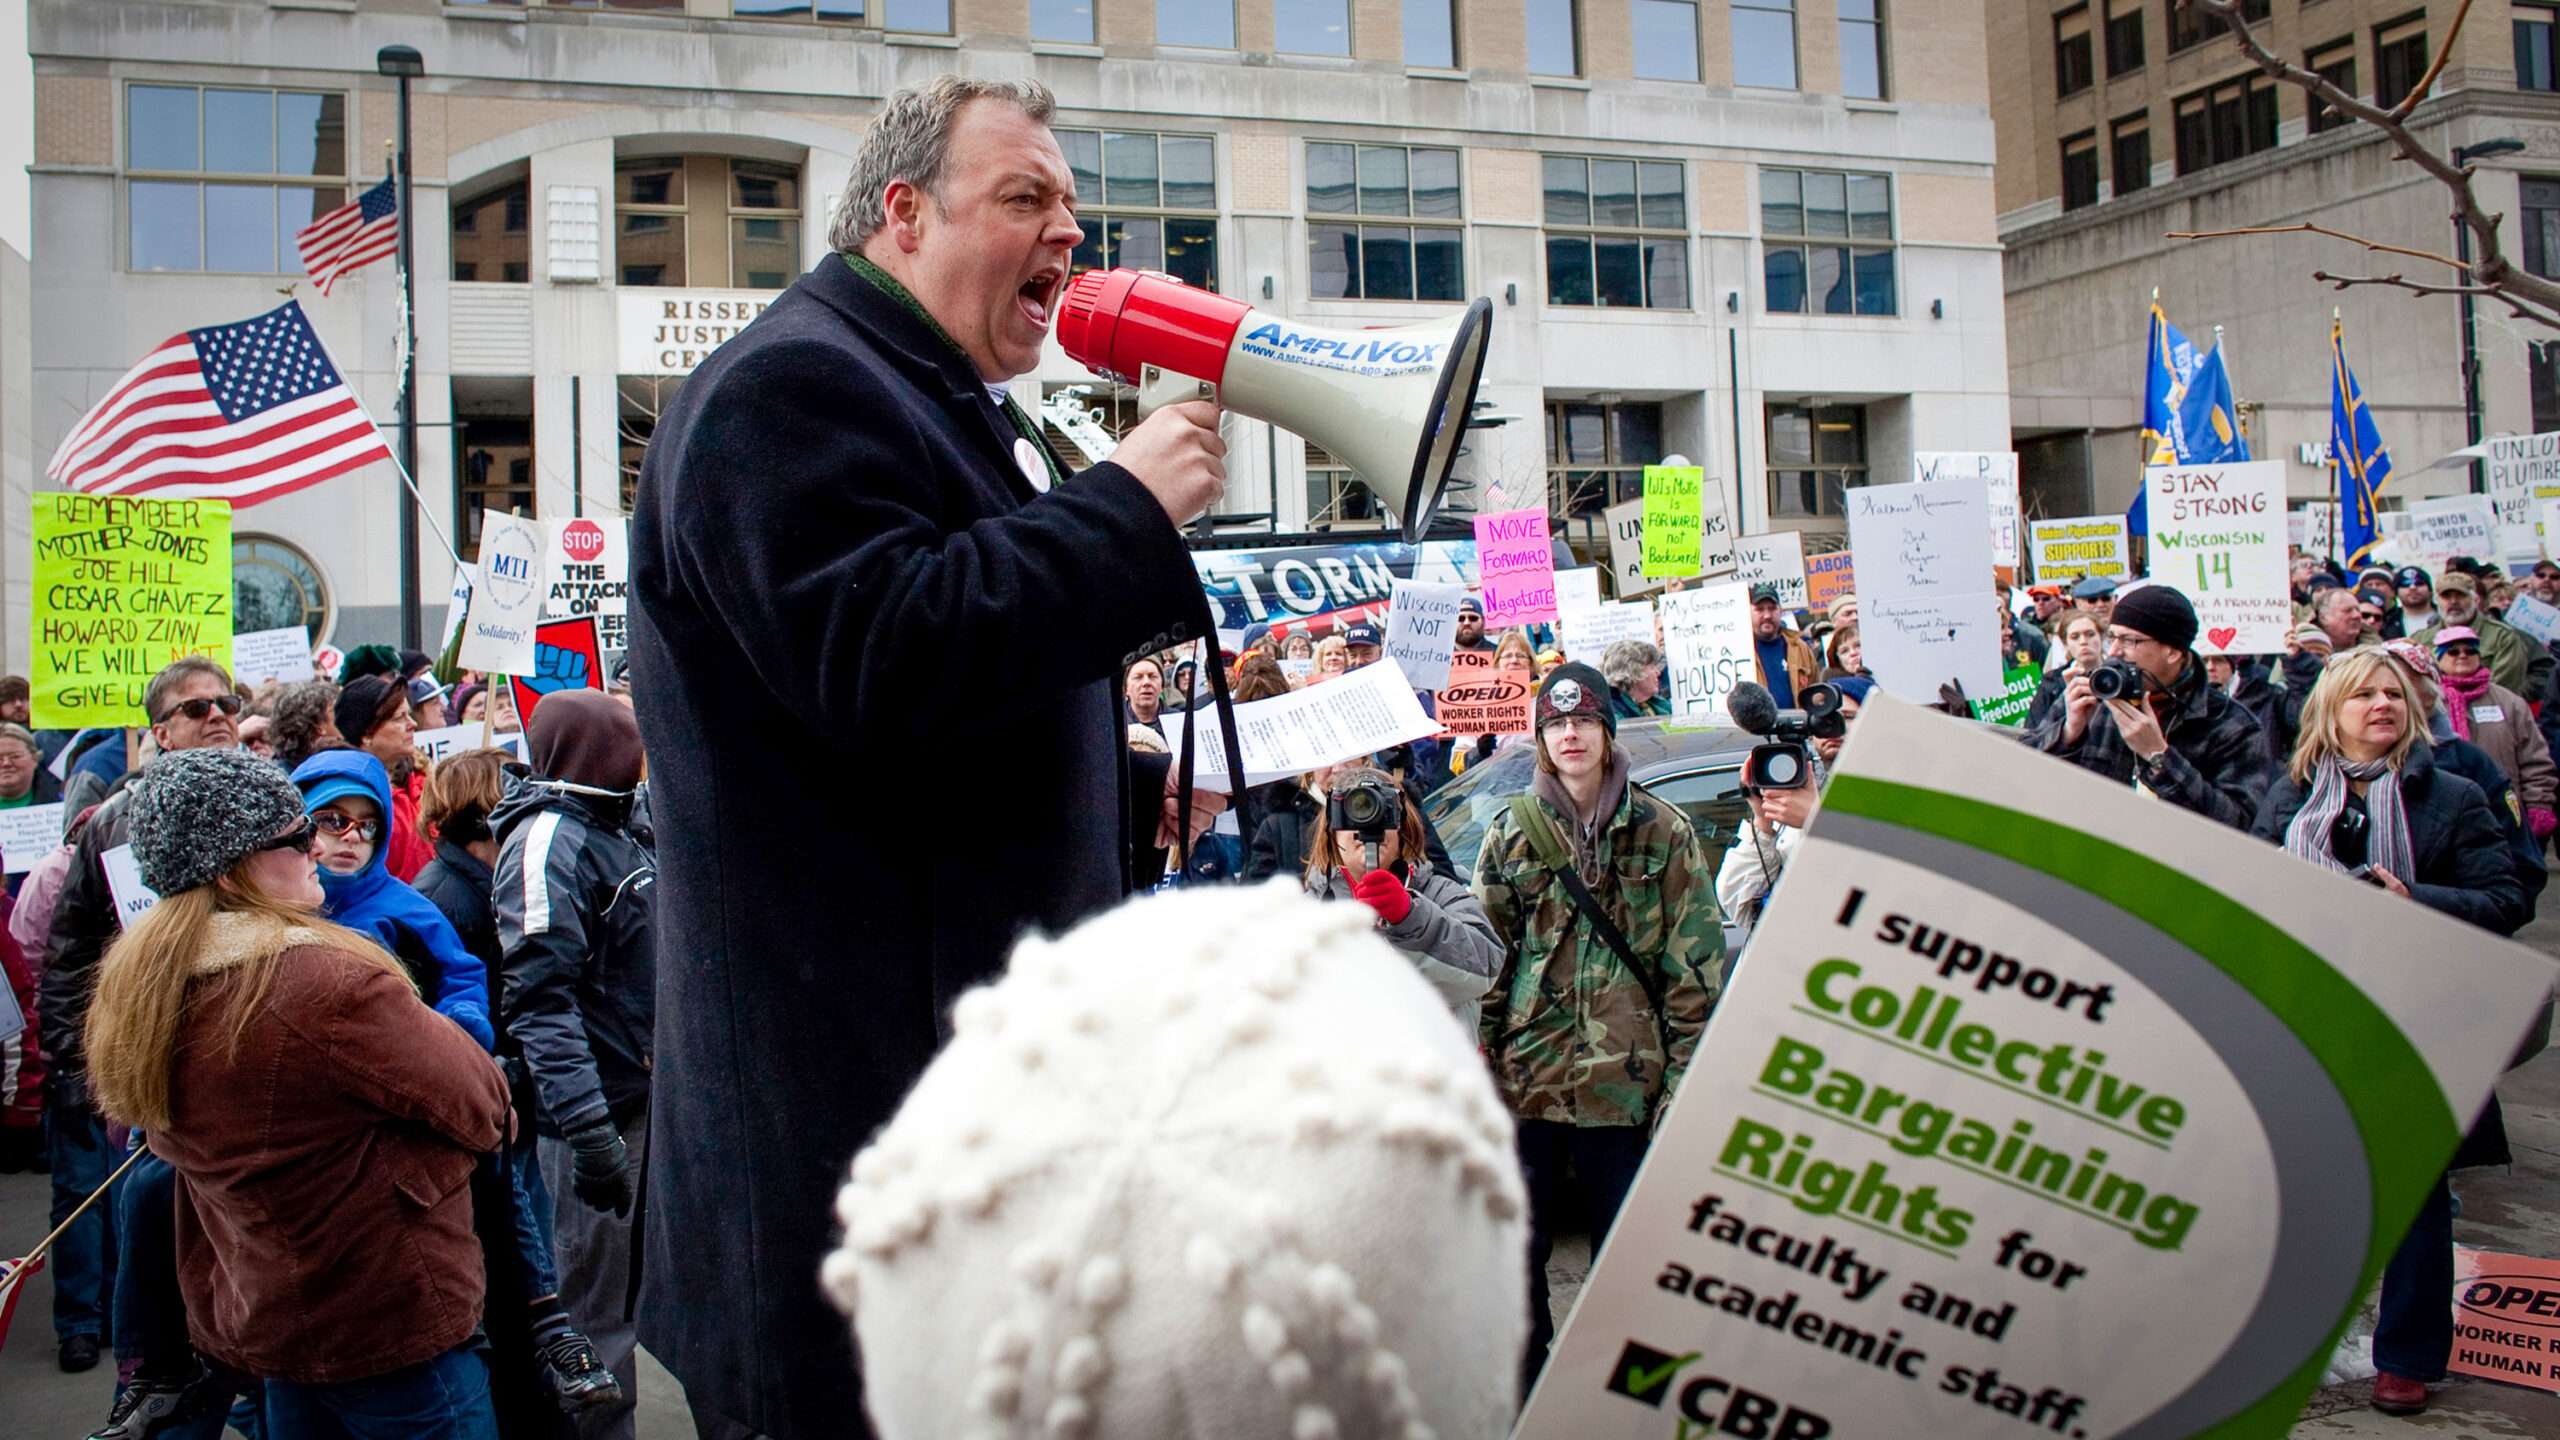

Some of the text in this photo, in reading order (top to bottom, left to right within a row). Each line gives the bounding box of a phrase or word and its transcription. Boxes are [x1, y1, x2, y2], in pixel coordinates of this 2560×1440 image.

[2162, 471, 2224, 494] STAY
[57, 496, 200, 528] REMEMBER
[2173, 492, 2266, 521] STRONG
[1488, 517, 1542, 543] MOVE
[2427, 513, 2467, 527] UNION
[38, 526, 208, 565] MOTHER JONES
[564, 531, 602, 549] STOP
[1666, 530, 1686, 545] not
[2156, 530, 2265, 550] WISCONSIN
[2421, 526, 2484, 541] PLUMBERS
[2044, 540, 2115, 561] SUPPORTS
[71, 557, 182, 585] JOE HILL
[493, 553, 528, 580] MTI
[562, 564, 605, 581] THE
[1806, 555, 1853, 574] LABOR
[2039, 564, 2088, 579] Workers
[2196, 552, 2233, 592] 14
[49, 584, 225, 616] CESAR CHAVEZ
[550, 582, 627, 599] ATTACK
[570, 600, 598, 614] ON
[1663, 599, 1687, 622] My
[44, 618, 200, 645] HOWARD ZINN
[476, 622, 526, 645] Solidarity!
[1408, 615, 1446, 637] NOT
[50, 649, 92, 674] WE
[103, 648, 156, 675] WILL
[1451, 653, 1489, 667] TOP
[1720, 645, 1732, 657] a
[1676, 659, 1751, 698] HOUSE
[57, 683, 144, 708] GIVE U
[1447, 686, 1513, 702] OPEIU
[1441, 706, 1526, 720] WORKER RIGHTS
[1450, 720, 1528, 734] HUMAN RIGHTS
[1835, 886, 2116, 1024] I support
[1805, 957, 2187, 1141] Collective
[1758, 1035, 2201, 1251] Bargaining
[1717, 1116, 2087, 1292] Rights for
[1686, 1195, 2017, 1342] faculty and
[2454, 1323, 2542, 1352] WORKER
[1657, 1260, 2088, 1440] academic staff.
[2459, 1349, 2542, 1377] HUMAN
